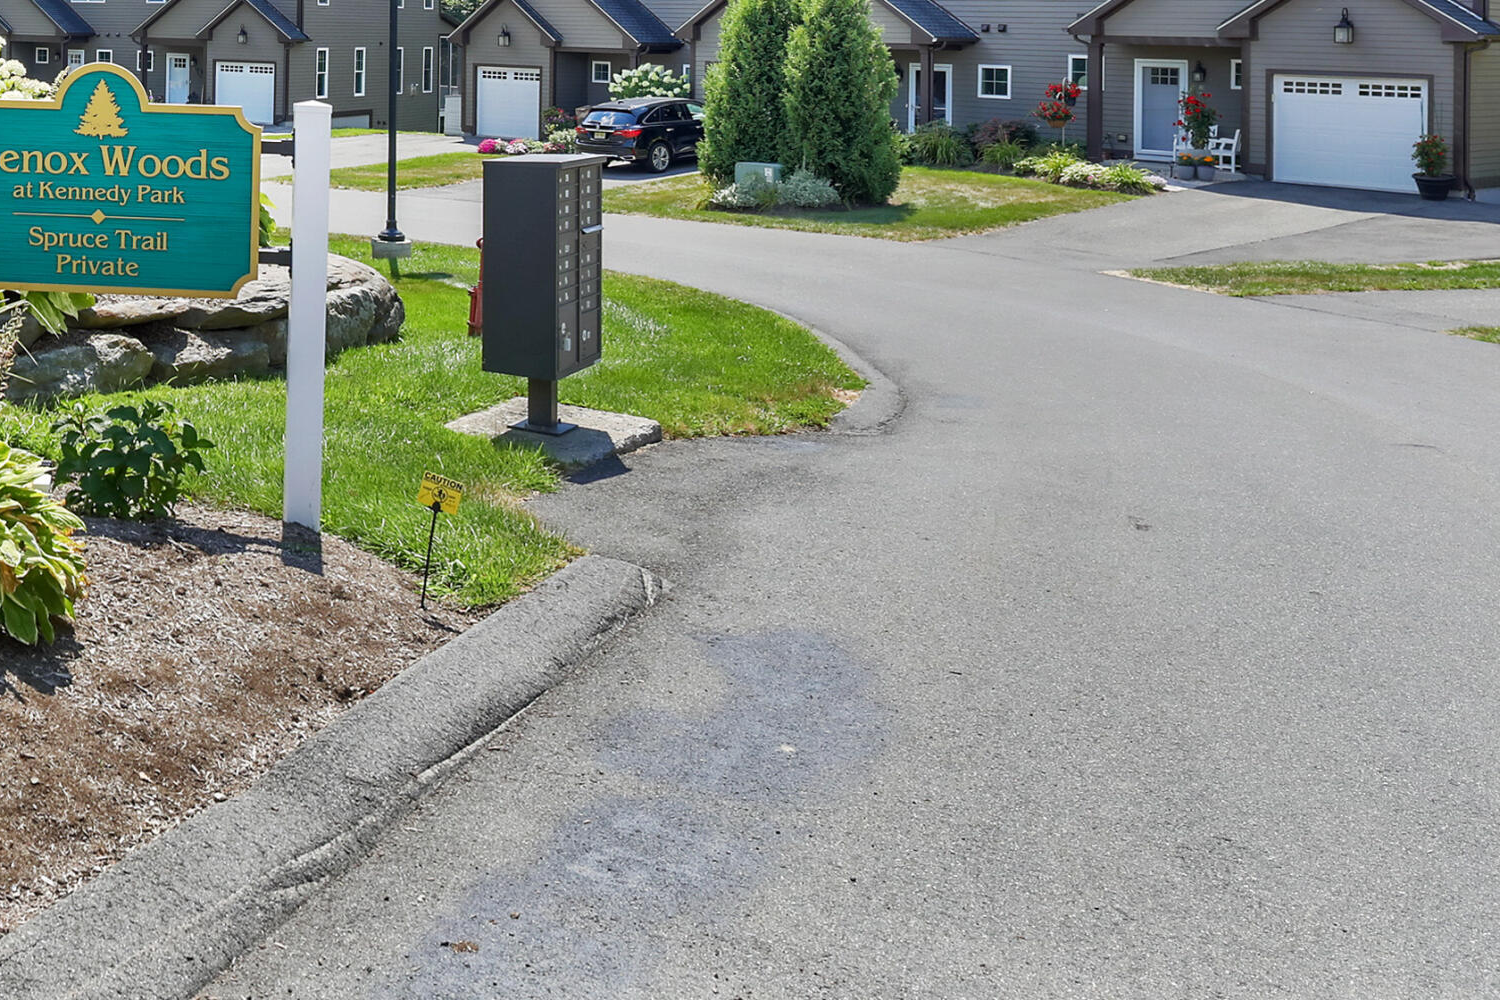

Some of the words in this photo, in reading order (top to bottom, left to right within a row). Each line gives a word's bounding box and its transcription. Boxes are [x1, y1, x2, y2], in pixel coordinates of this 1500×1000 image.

[100, 145, 230, 180] Woods
[12, 183, 33, 198] at
[38, 181, 131, 206] Kennedy
[137, 184, 185, 204] Park
[28, 226, 108, 251] Spruce
[115, 229, 168, 251] Trail
[56, 254, 139, 276] Private
[424, 471, 463, 490] CAUTION
